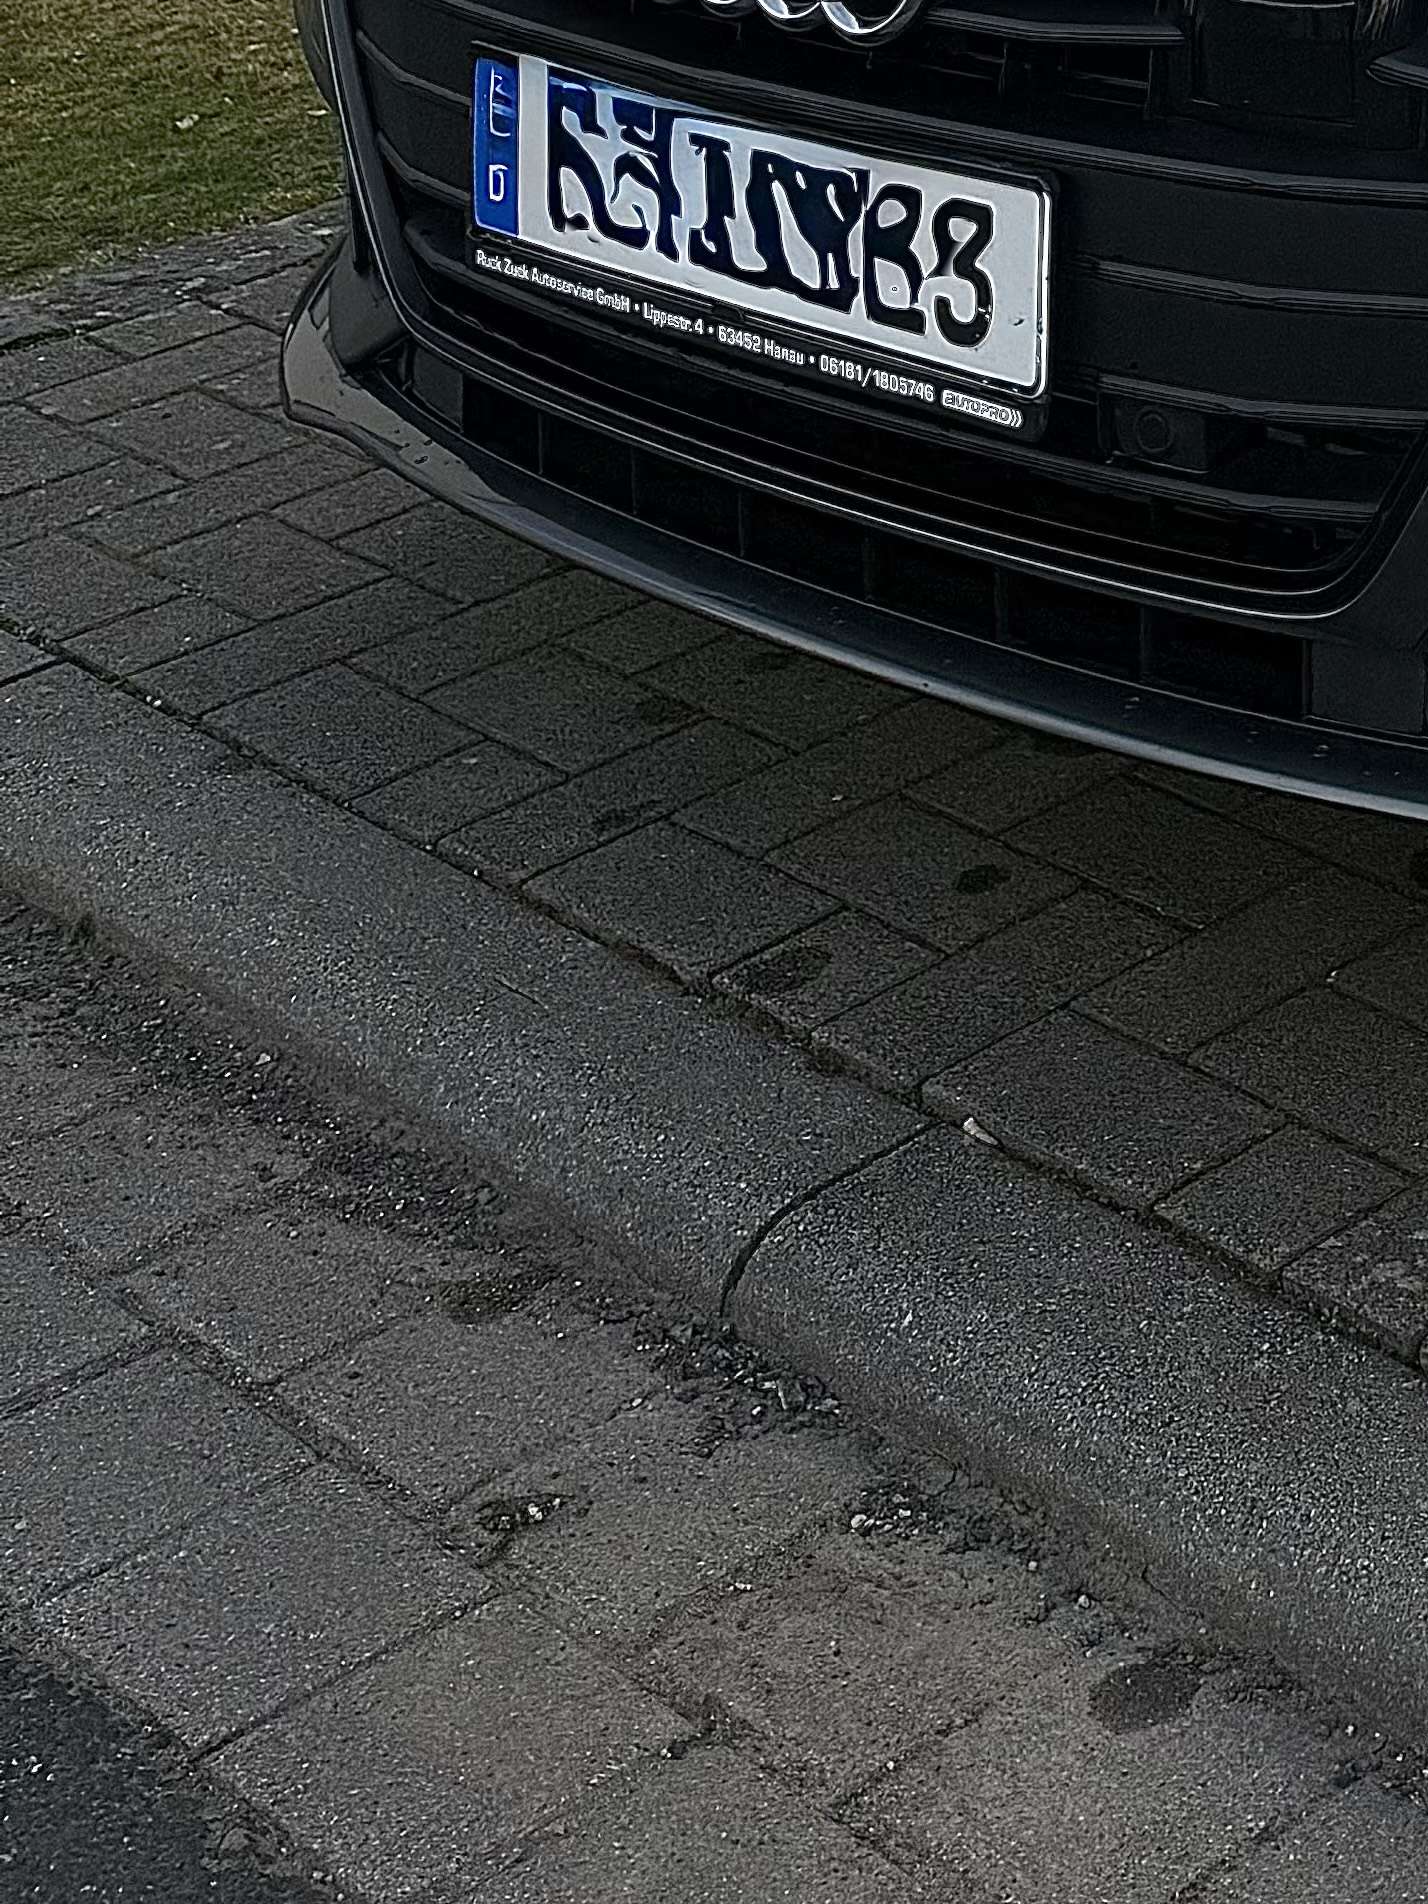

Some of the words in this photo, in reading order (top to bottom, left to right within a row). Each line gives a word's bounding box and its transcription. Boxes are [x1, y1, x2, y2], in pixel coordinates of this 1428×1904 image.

[488, 163, 508, 202] D
[531, 267, 594, 301] Autoservice
[596, 287, 630, 313] GmbH
[643, 302, 693, 332] Lippestr.
[694, 318, 704, 334] 4
[717, 325, 761, 353] 63452
[764, 339, 804, 365] Hanau
[819, 354, 935, 402] 06181/1805746
